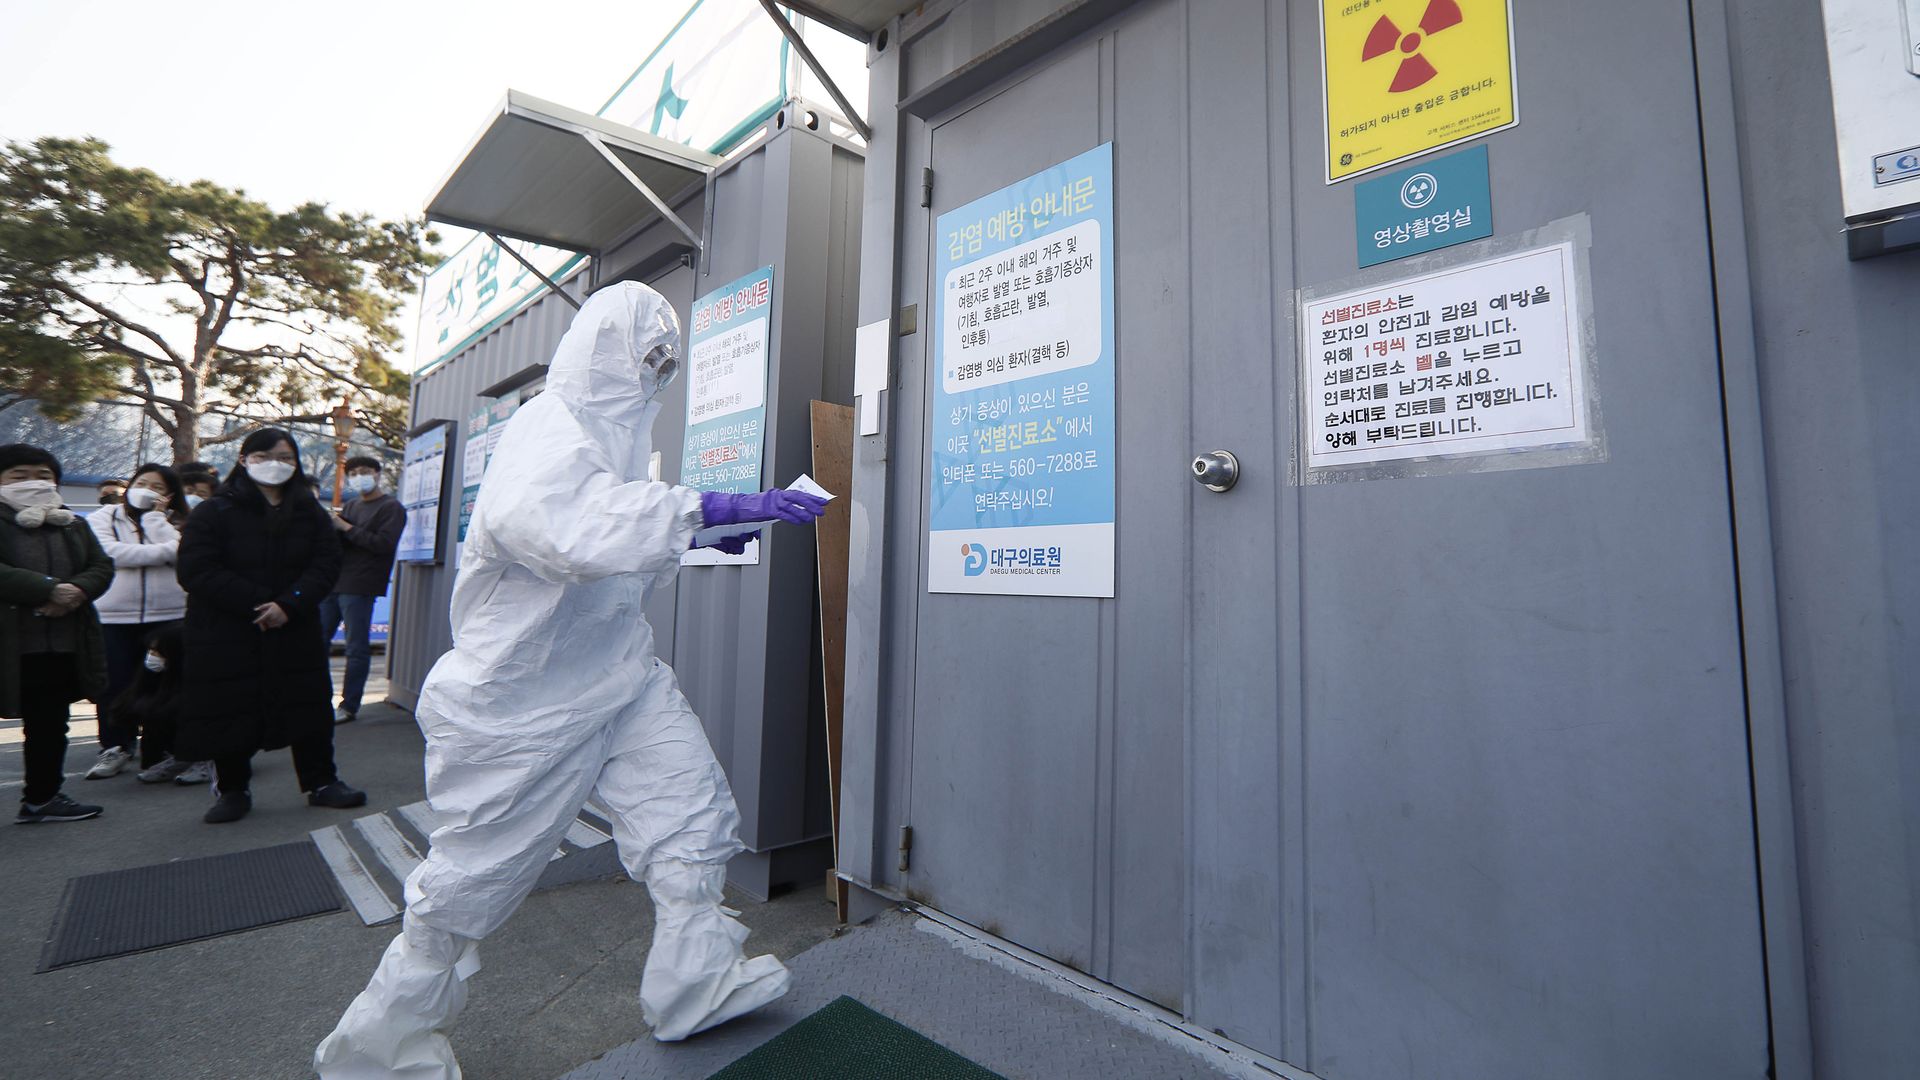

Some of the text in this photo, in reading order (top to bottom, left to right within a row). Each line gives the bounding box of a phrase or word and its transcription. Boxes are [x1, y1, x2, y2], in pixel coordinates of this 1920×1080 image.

[1340, 118, 1377, 137] 허가되지
[1381, 107, 1410, 123] 아니한
[1449, 76, 1497, 101] 금합니다.
[948, 175, 1097, 261] 감염 예방 안내문
[1374, 206, 1472, 248] 영상촬영실
[958, 253, 1093, 309] 여행자로 발열 또는 호흡기증상자
[959, 236, 1077, 290] 최근 2주 이내 해외 거주 및
[695, 279, 769, 333] 감염 예방 안내문
[958, 290, 1050, 330] (기침, 호흡곤란, 발열,
[1321, 294, 1414, 325] 선별진료소는
[1322, 285, 1551, 346] 환자의 안전과 감염 예방을
[961, 329, 990, 350] 인후통)
[1323, 317, 1517, 366] 위해 1명씩 진료합니다.
[958, 340, 1070, 381] 감염병 의심 환자(결핵 등)
[1323, 338, 1522, 386] 선별진료소 벨을 누르고
[950, 382, 1090, 426] 상기 증상이 있으신 분은
[1324, 367, 1499, 407] 연락처를 남겨주세요.
[1324, 382, 1558, 428] 순서대로 진료를 진행합니다.
[720, 423, 740, 442] 있으신
[742, 420, 757, 437] 분은
[947, 435, 969, 455] 이곳
[1325, 417, 1482, 449] 양해 부탁드립니다.
[943, 450, 1098, 485] 인터폰 또는 560-7288로
[975, 487, 1054, 512] 연락주십시오!
[991, 547, 1061, 567] 대구의료원
